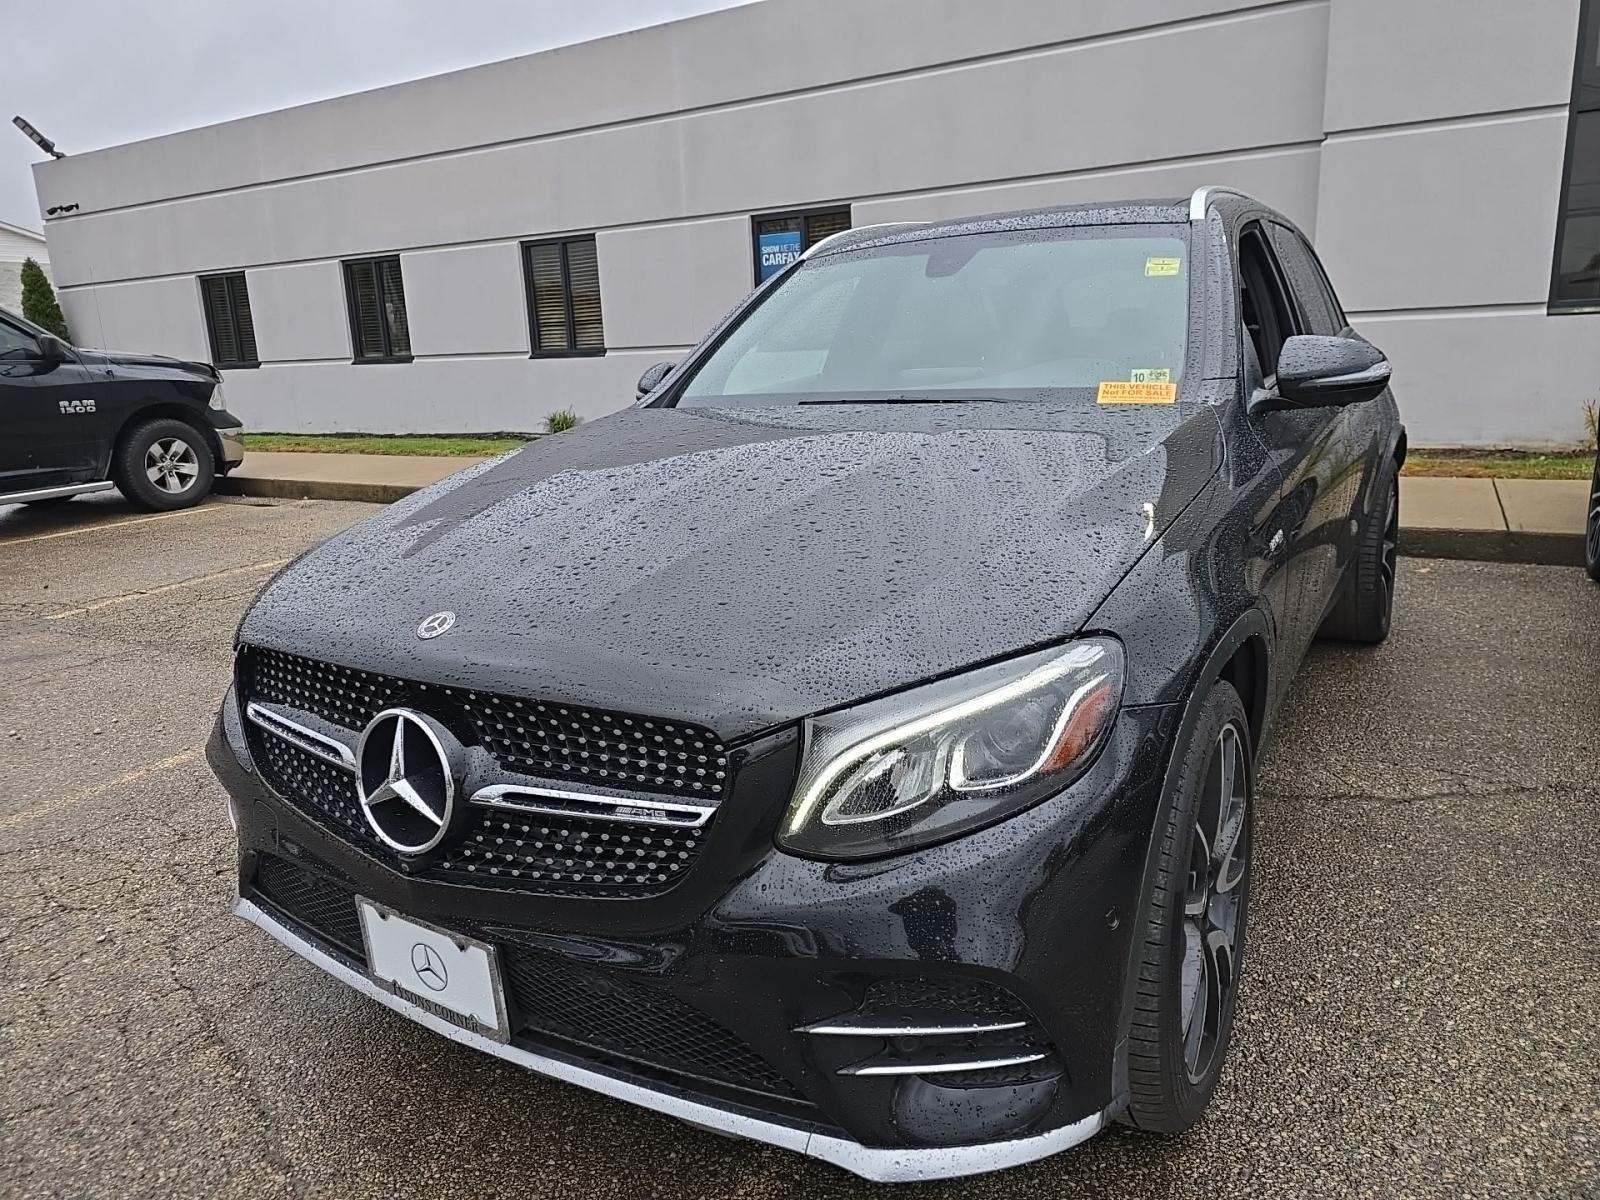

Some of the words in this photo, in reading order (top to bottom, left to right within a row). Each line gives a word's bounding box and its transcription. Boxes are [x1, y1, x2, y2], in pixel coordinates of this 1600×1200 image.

[761, 244, 780, 254] SHOW
[1133, 373, 1145, 383] 10
[60, 406, 96, 414] 1500
[631, 807, 666, 817] AMG
[434, 1002, 480, 1034] CORNER
